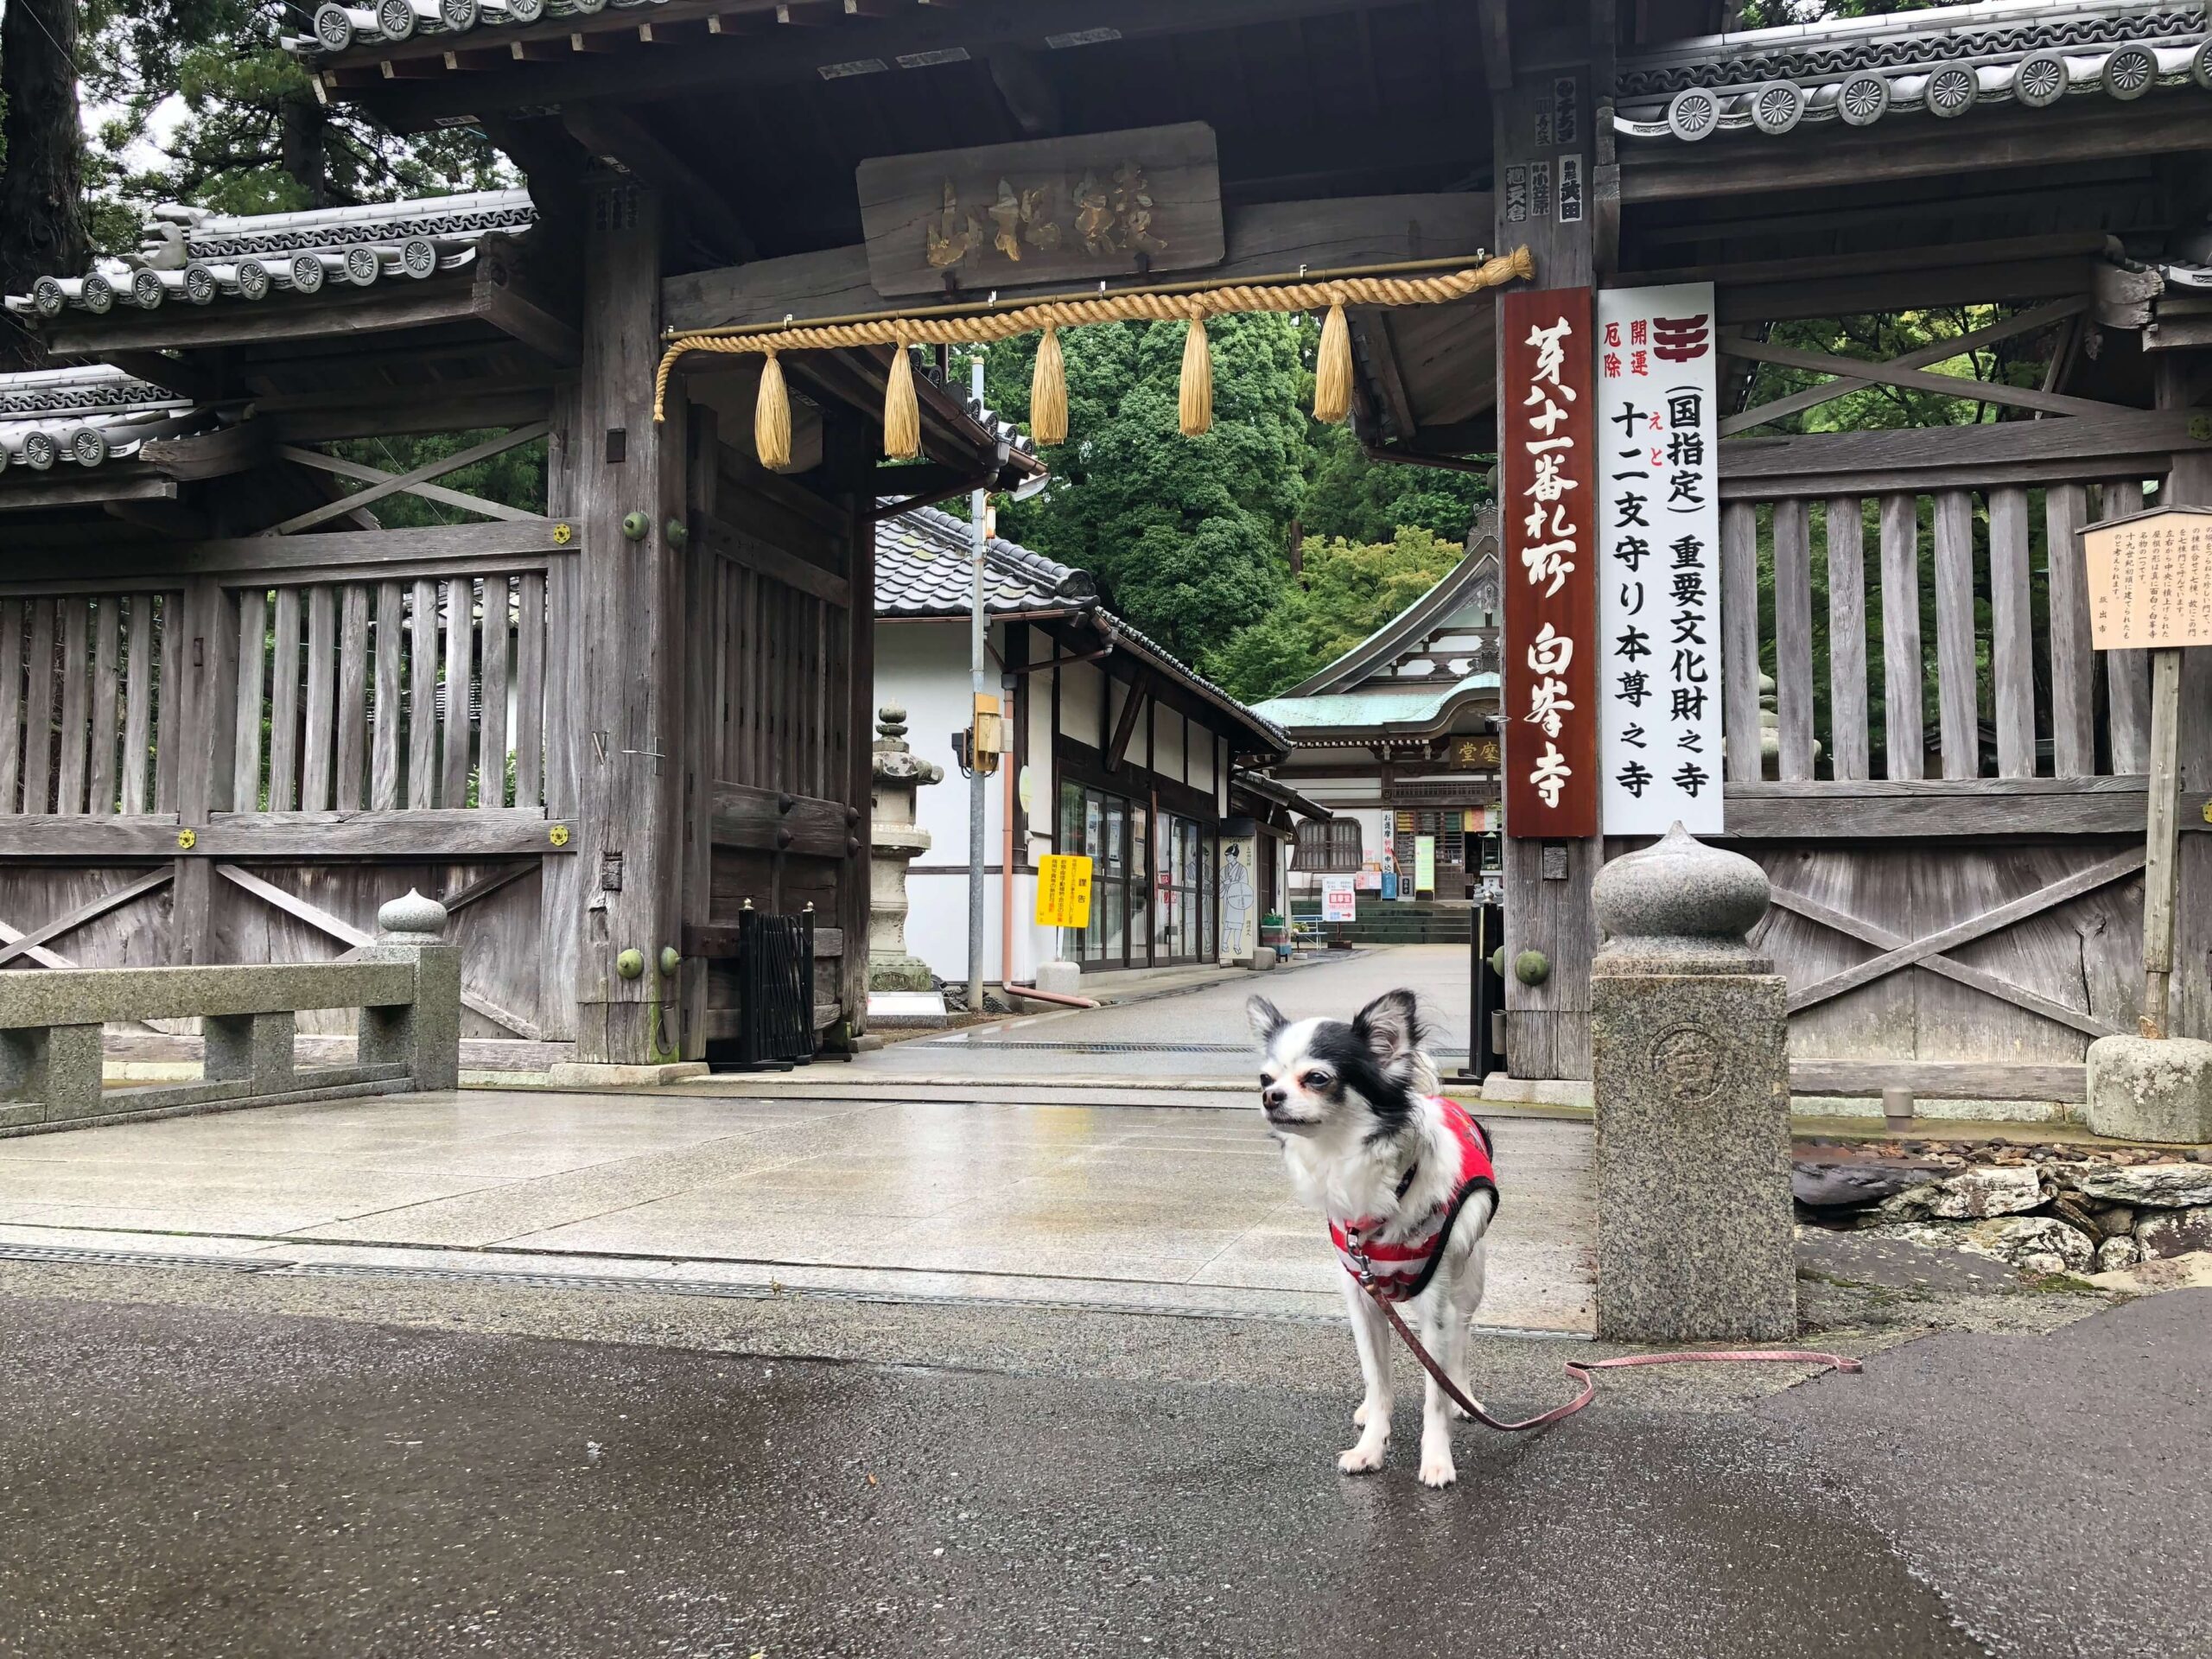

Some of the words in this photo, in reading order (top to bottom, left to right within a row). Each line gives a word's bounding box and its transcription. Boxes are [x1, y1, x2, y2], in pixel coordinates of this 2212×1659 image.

[1604, 321, 1622, 378] 厄除
[1630, 319, 1649, 377] 開運
[1649, 411, 1664, 467] えと
[1611, 402, 1654, 798] 十二支守り本尊之寺
